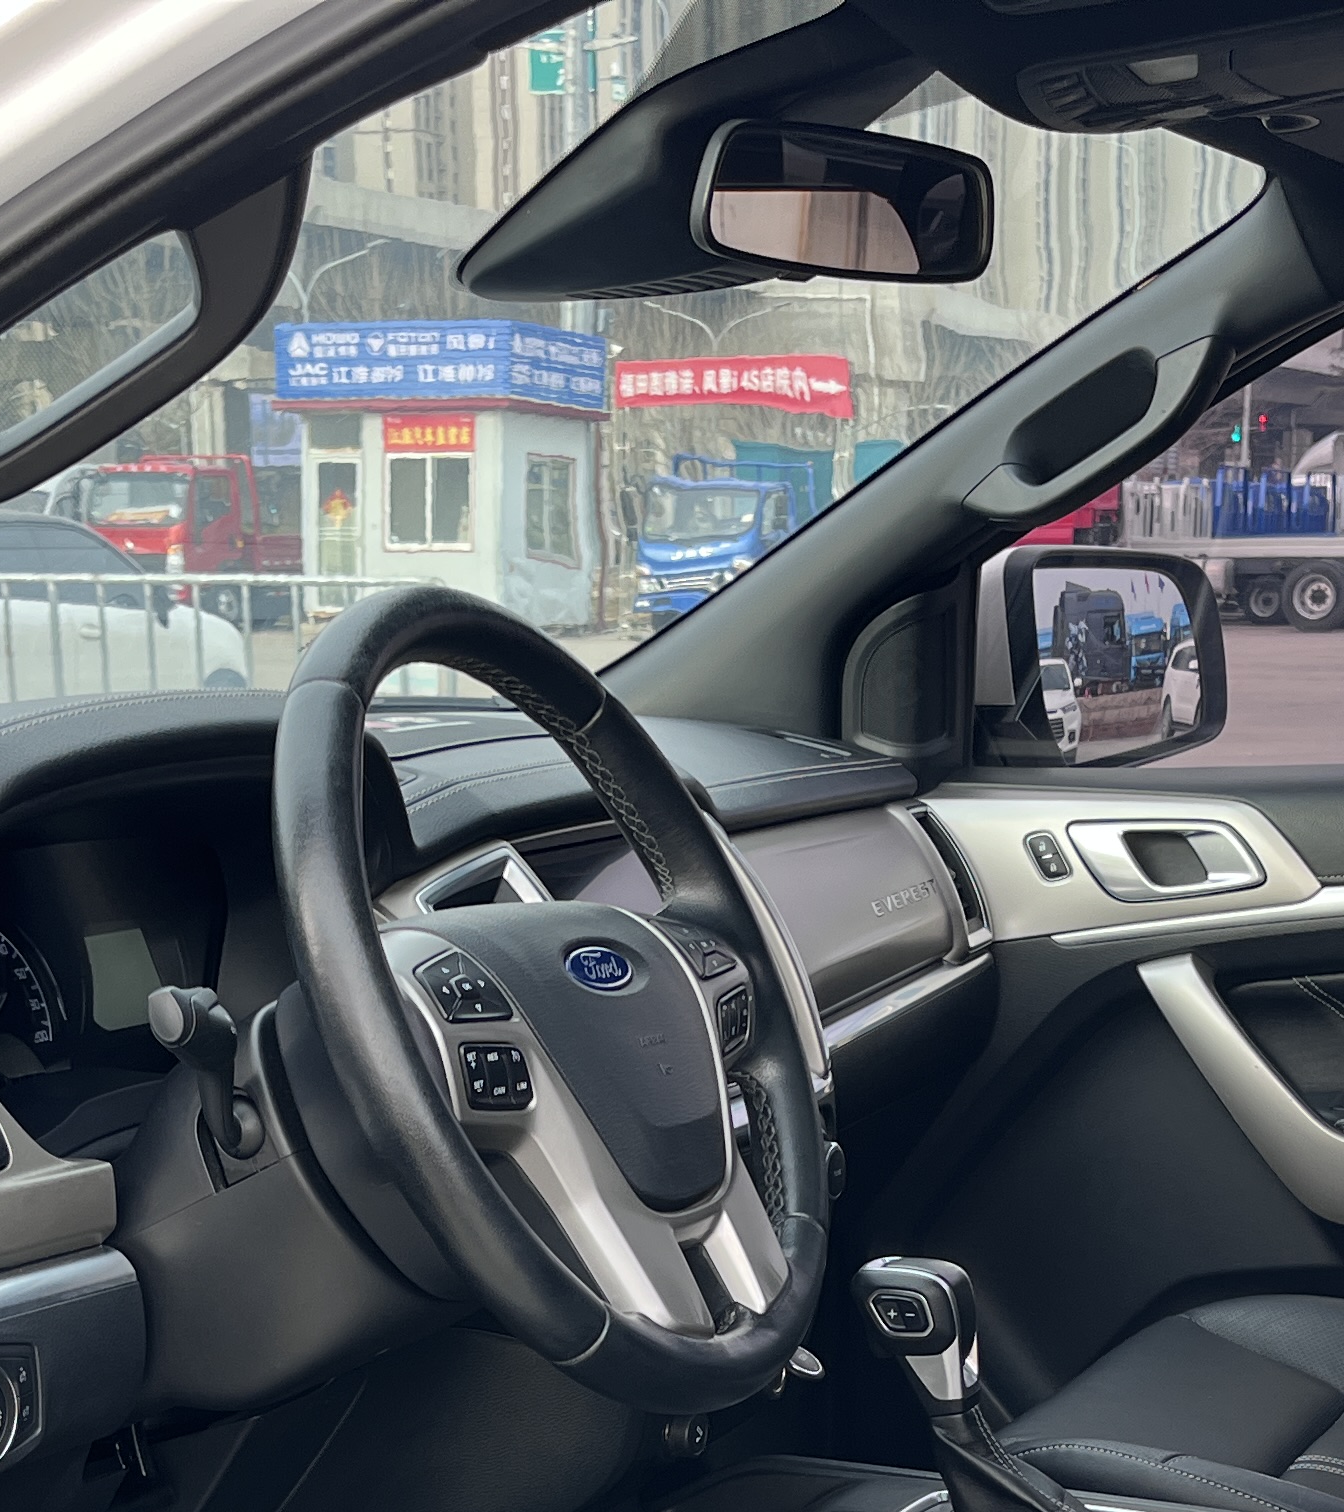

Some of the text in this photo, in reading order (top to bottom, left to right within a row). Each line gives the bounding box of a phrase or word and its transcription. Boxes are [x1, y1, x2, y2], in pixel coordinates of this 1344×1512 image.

[288, 363, 329, 376] JAC
[871, 878, 935, 917] EVEREST
[579, 951, 622, 979] Ford
